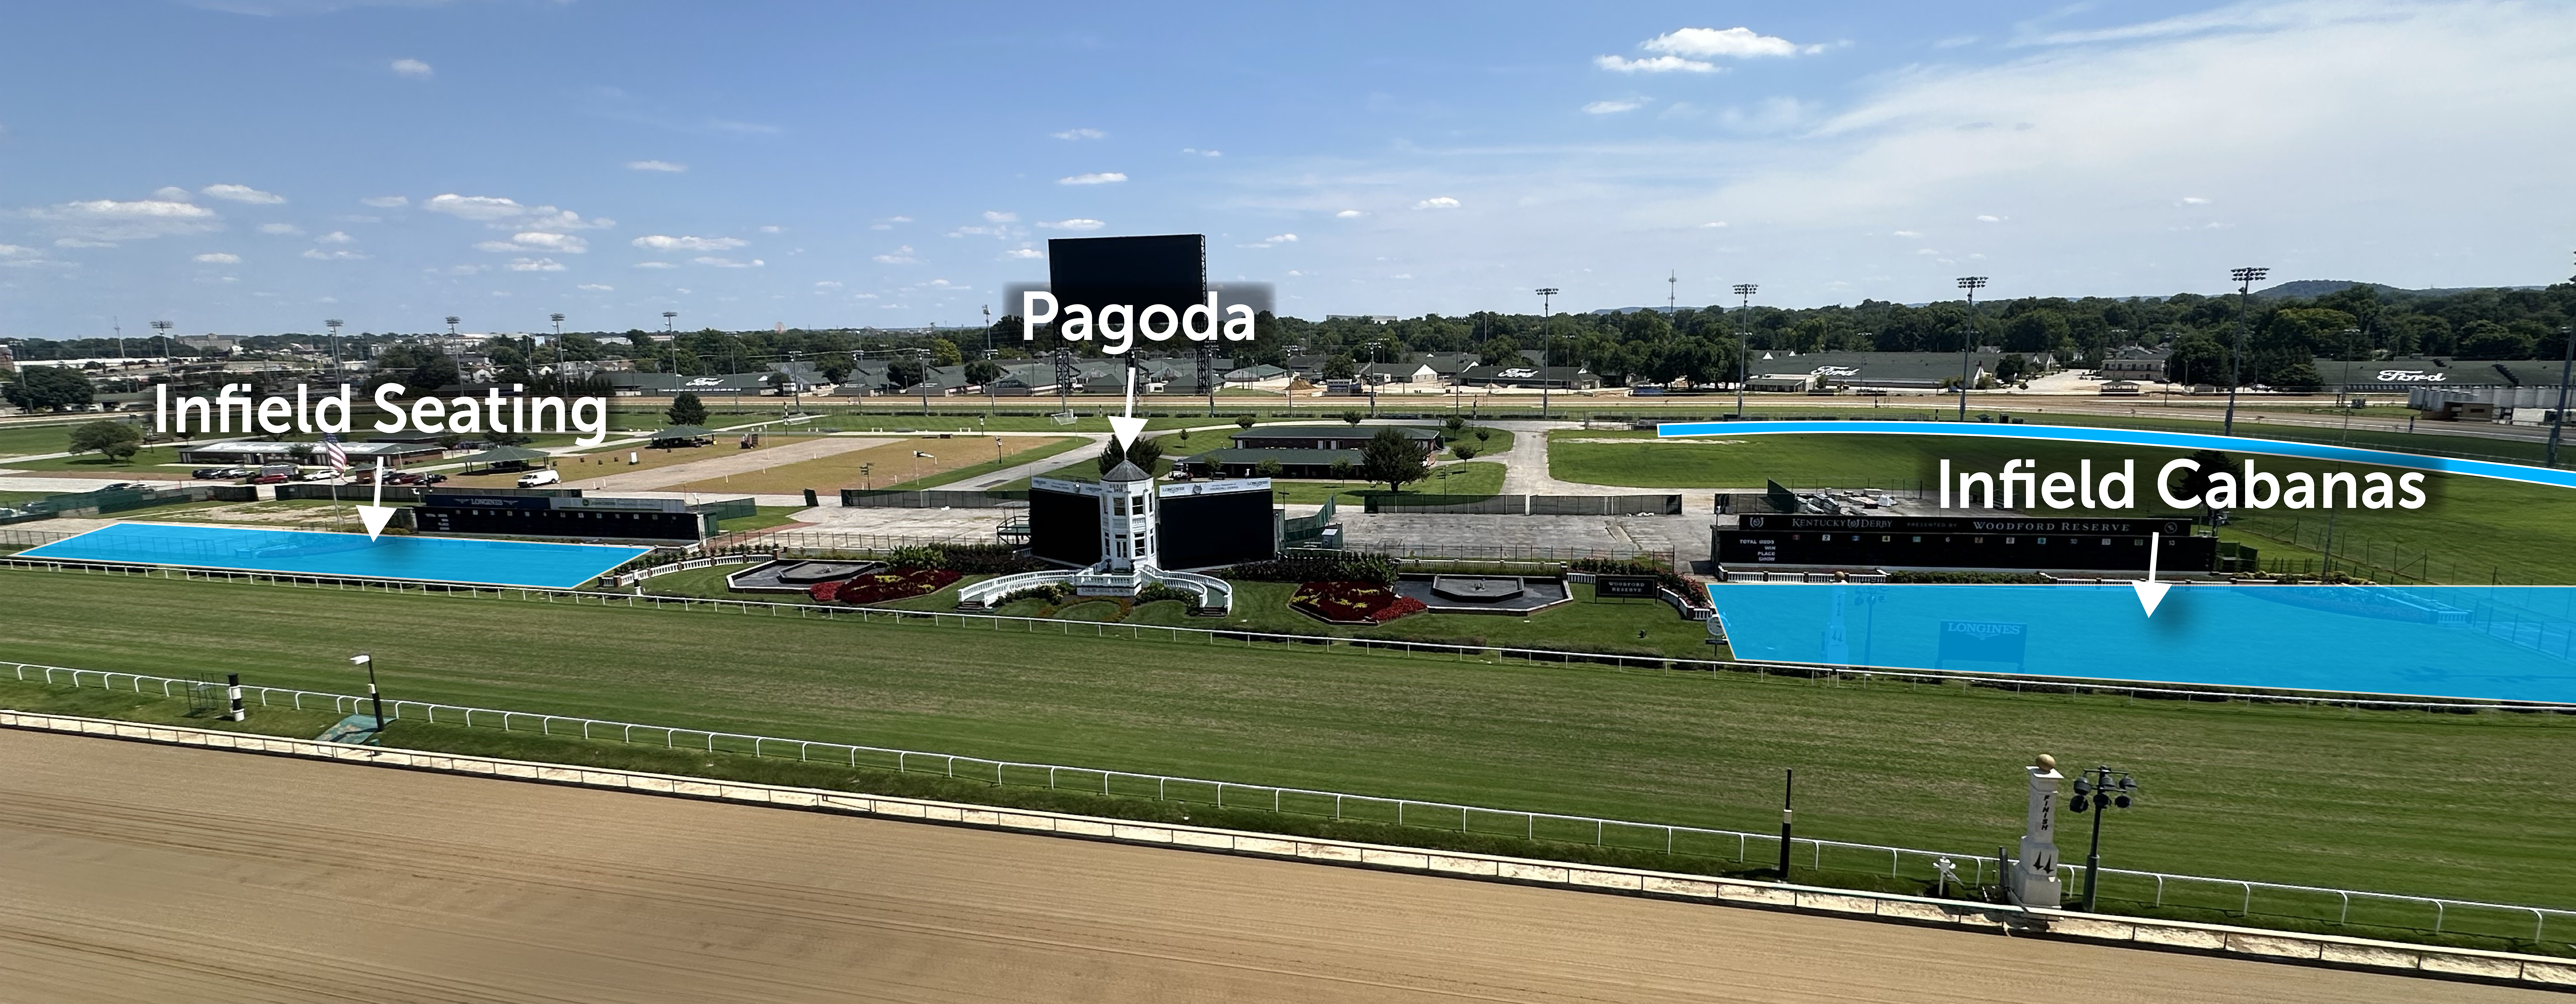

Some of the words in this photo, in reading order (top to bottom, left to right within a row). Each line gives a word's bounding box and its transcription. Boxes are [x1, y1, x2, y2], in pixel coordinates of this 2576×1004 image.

[1498, 368, 1539, 378] Ford
[1811, 365, 1860, 376] Ford
[2377, 370, 2447, 382] Ford
[1792, 518, 1846, 528] KENTUCKY
[1861, 519, 1892, 528] DERBY
[1973, 521, 2055, 530] WOODFORD
[2061, 522, 2129, 531] RESERVE
[1947, 623, 2020, 634] LONGINES
[2041, 795, 2050, 830] FINISH
